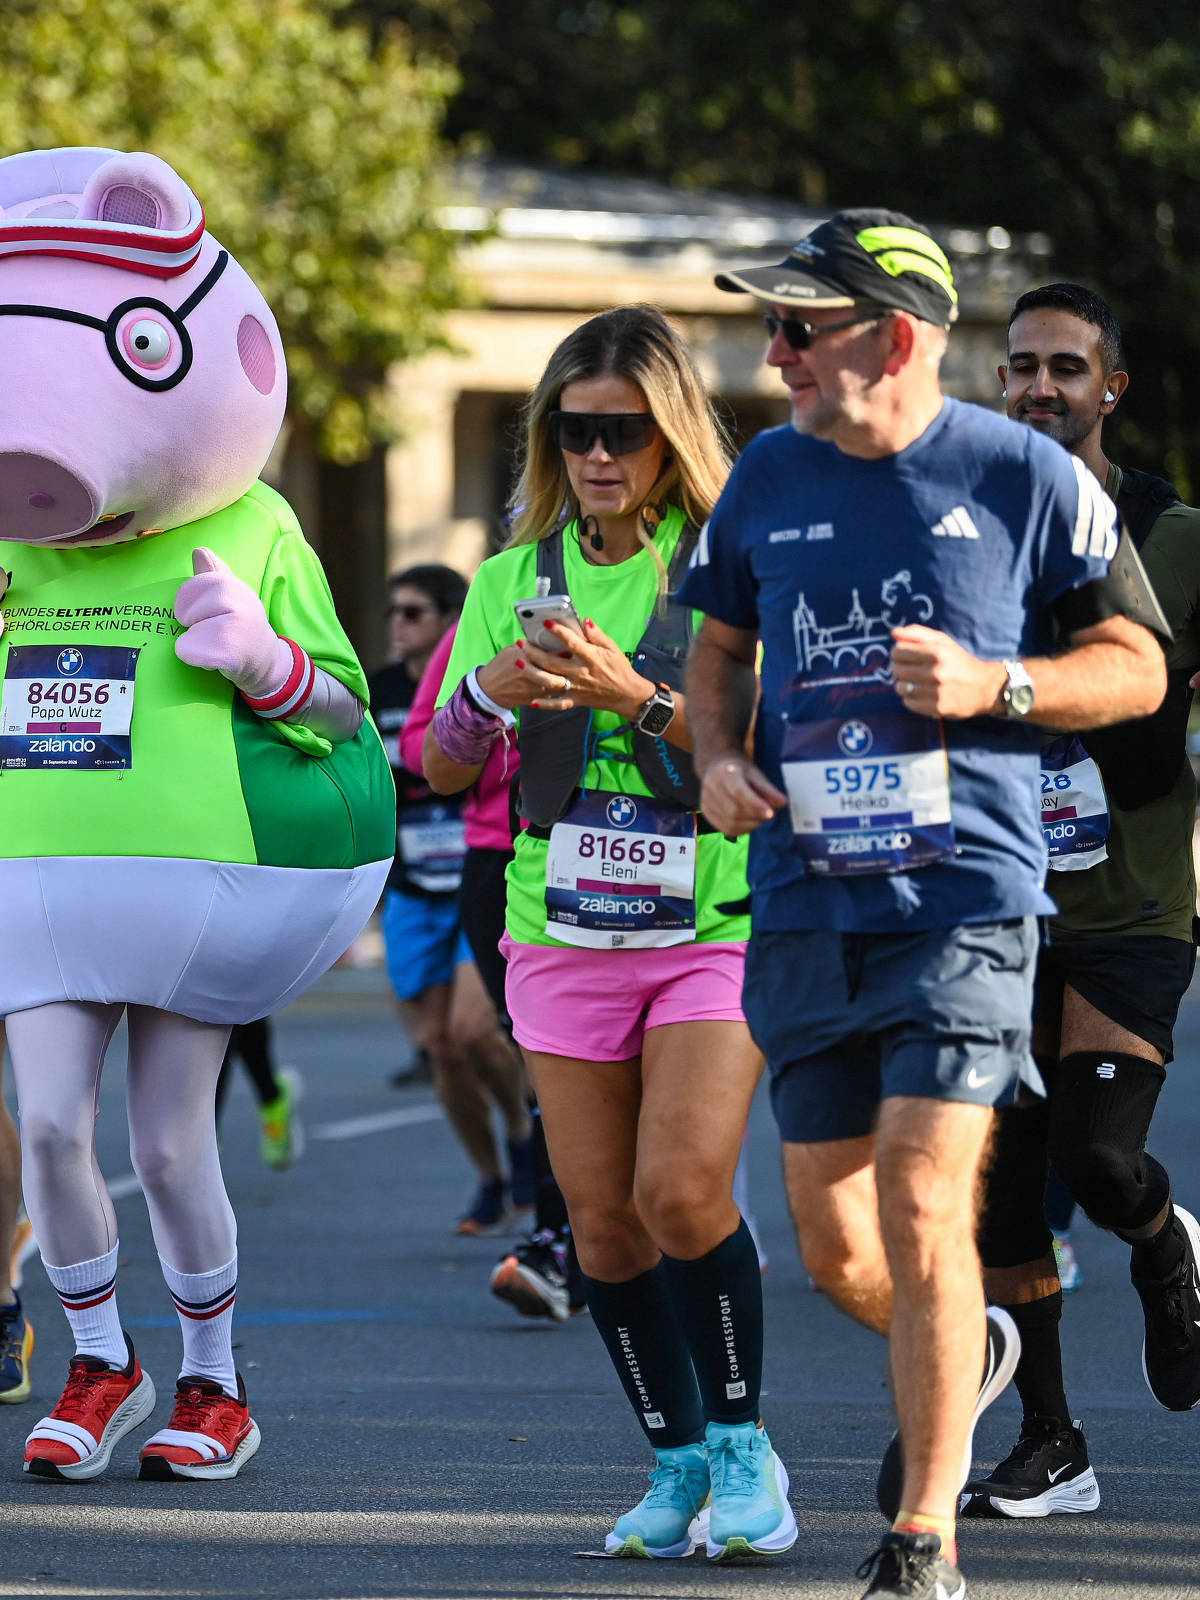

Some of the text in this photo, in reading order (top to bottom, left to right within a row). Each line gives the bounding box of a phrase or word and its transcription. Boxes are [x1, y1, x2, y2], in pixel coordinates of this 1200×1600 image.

[94, 619, 152, 633] KINDER
[28, 683, 110, 705] 84056
[31, 706, 102, 720] Papa Wutz
[60, 722, 67, 732] G
[29, 738, 96, 752] zalando
[825, 763, 902, 794] 5975
[840, 796, 890, 811] Heiko
[579, 833, 666, 866] 81669
[827, 832, 912, 854] zalando
[601, 862, 638, 880] Eleni
[579, 897, 656, 914] zalando
[719, 1294, 739, 1379] COMPRESSPORT
[617, 1326, 652, 1410] COMPRESSPORT
